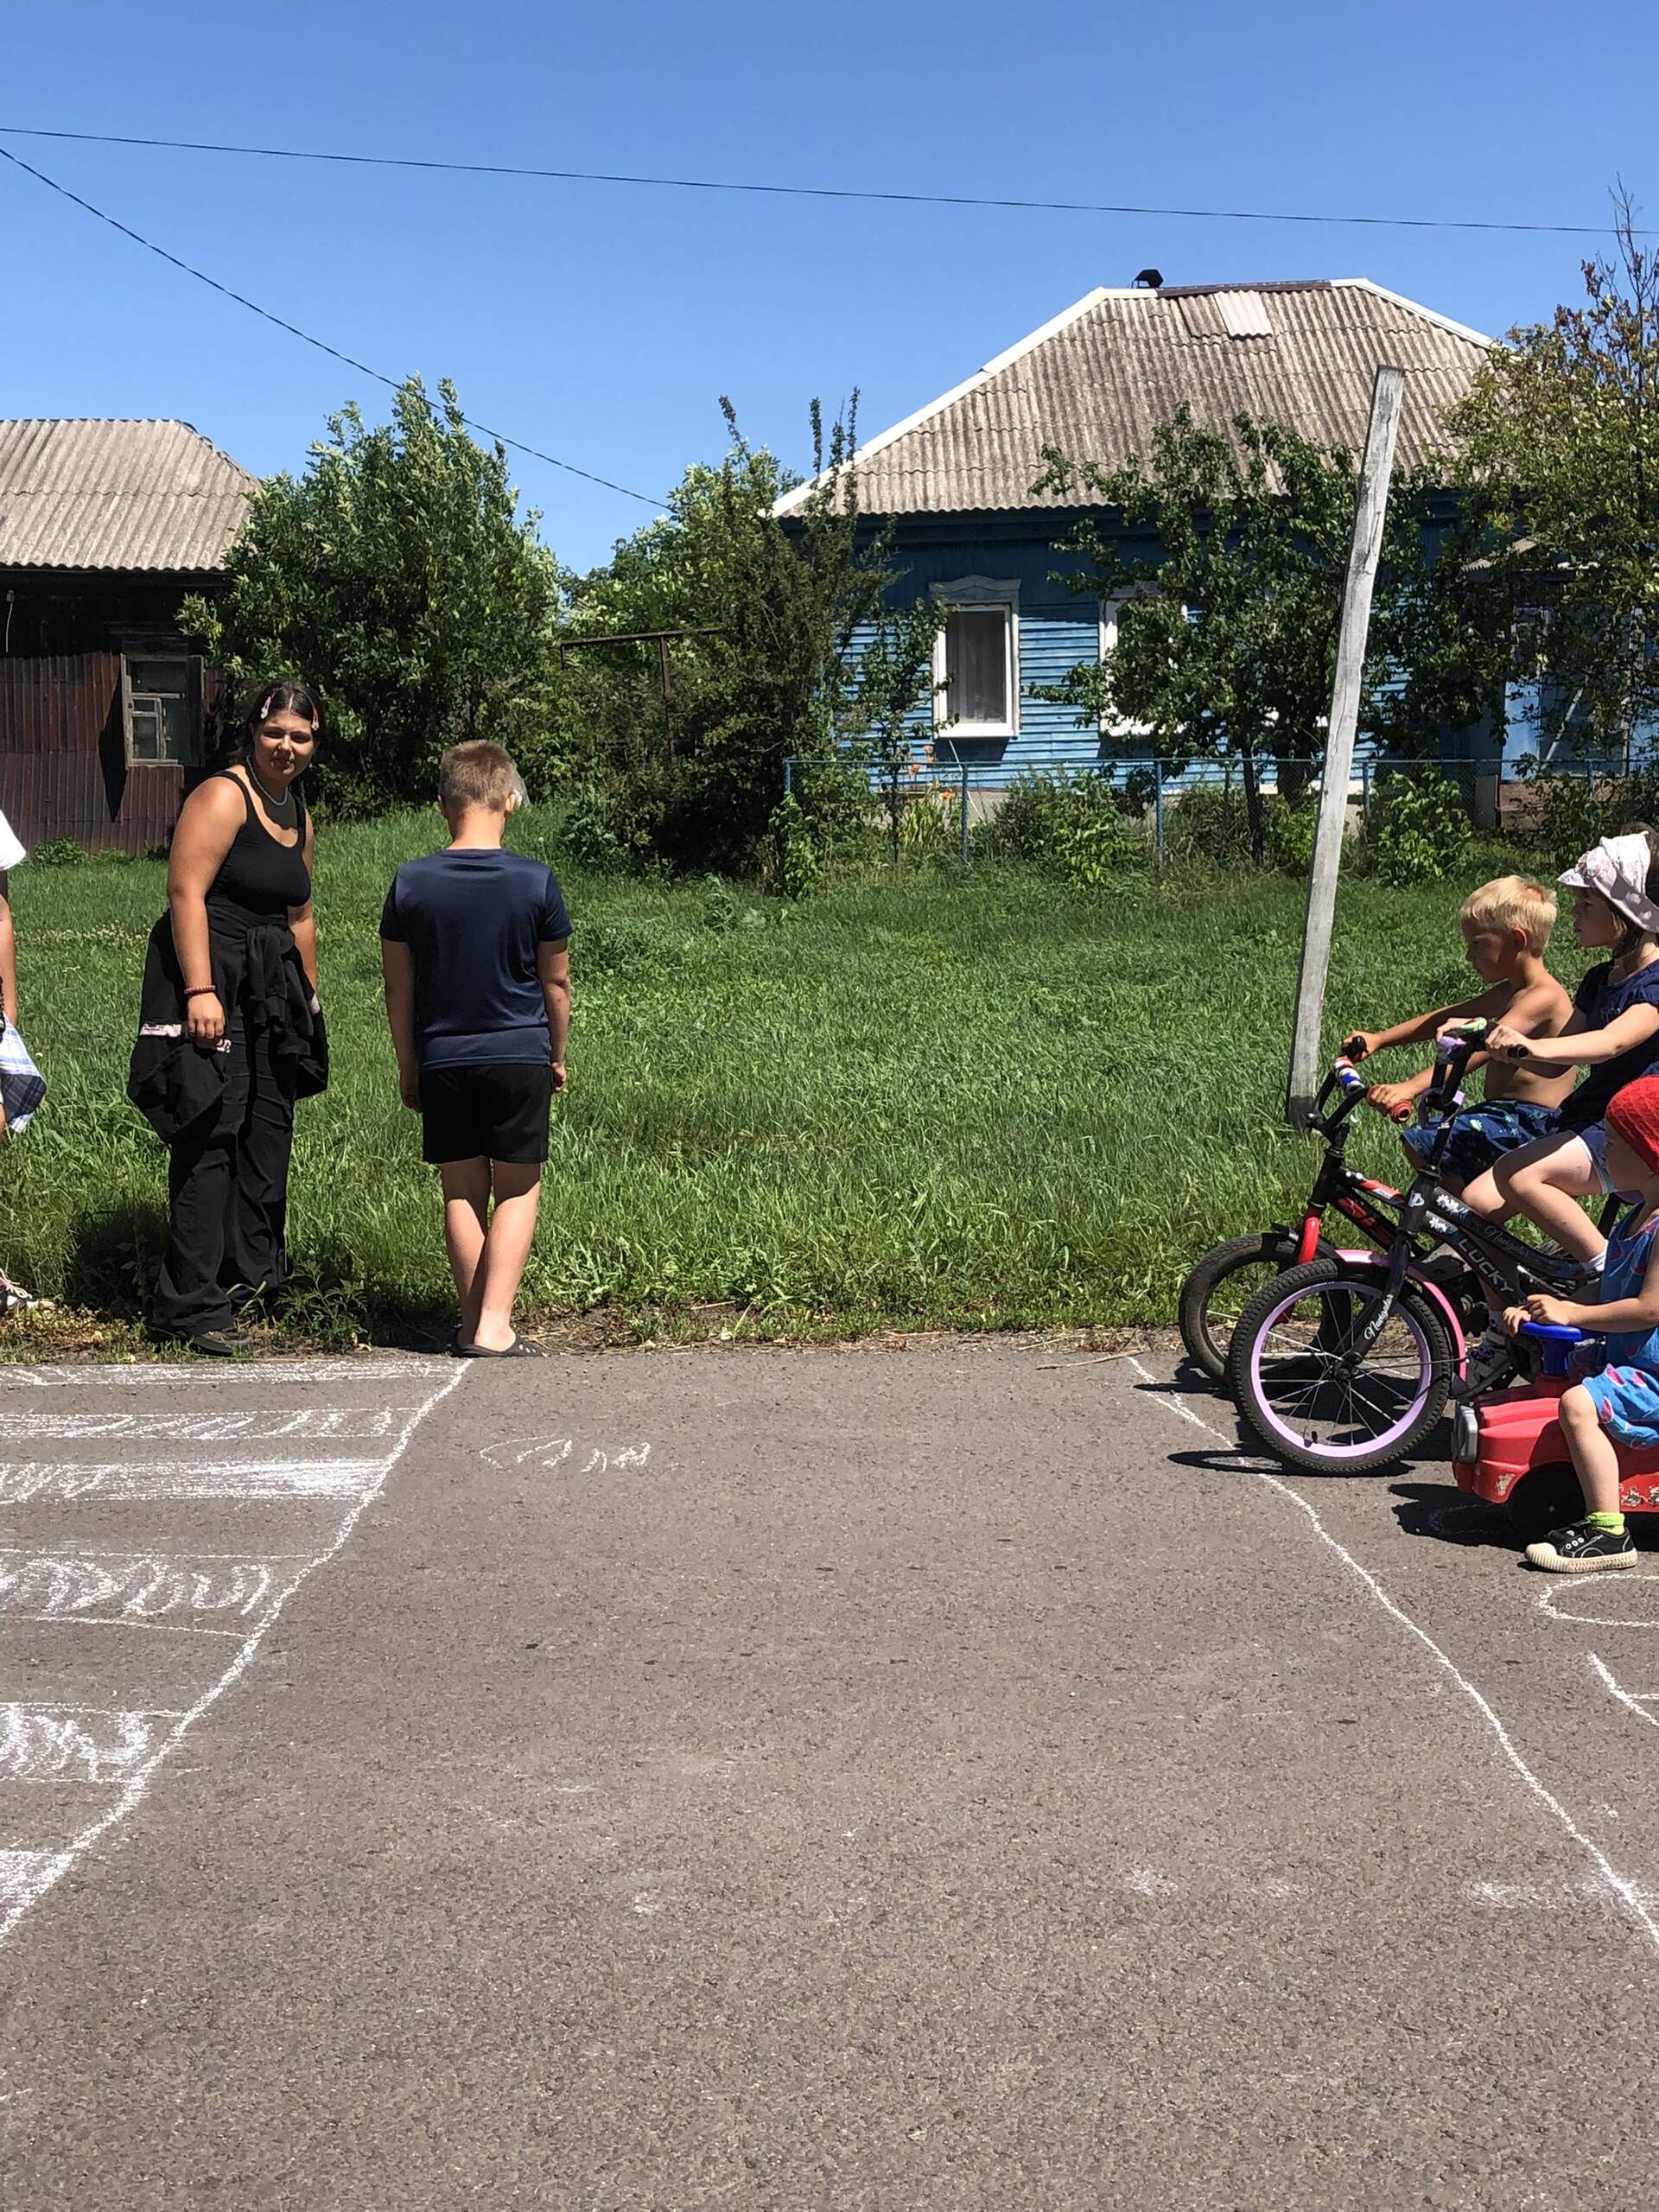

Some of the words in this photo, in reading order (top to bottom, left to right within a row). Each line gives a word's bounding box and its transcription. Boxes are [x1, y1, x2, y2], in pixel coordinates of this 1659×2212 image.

[1484, 1224, 1529, 1259] Navig
[1458, 1238, 1514, 1293] LUCKY
[1363, 1294, 1394, 1340] Navigator
